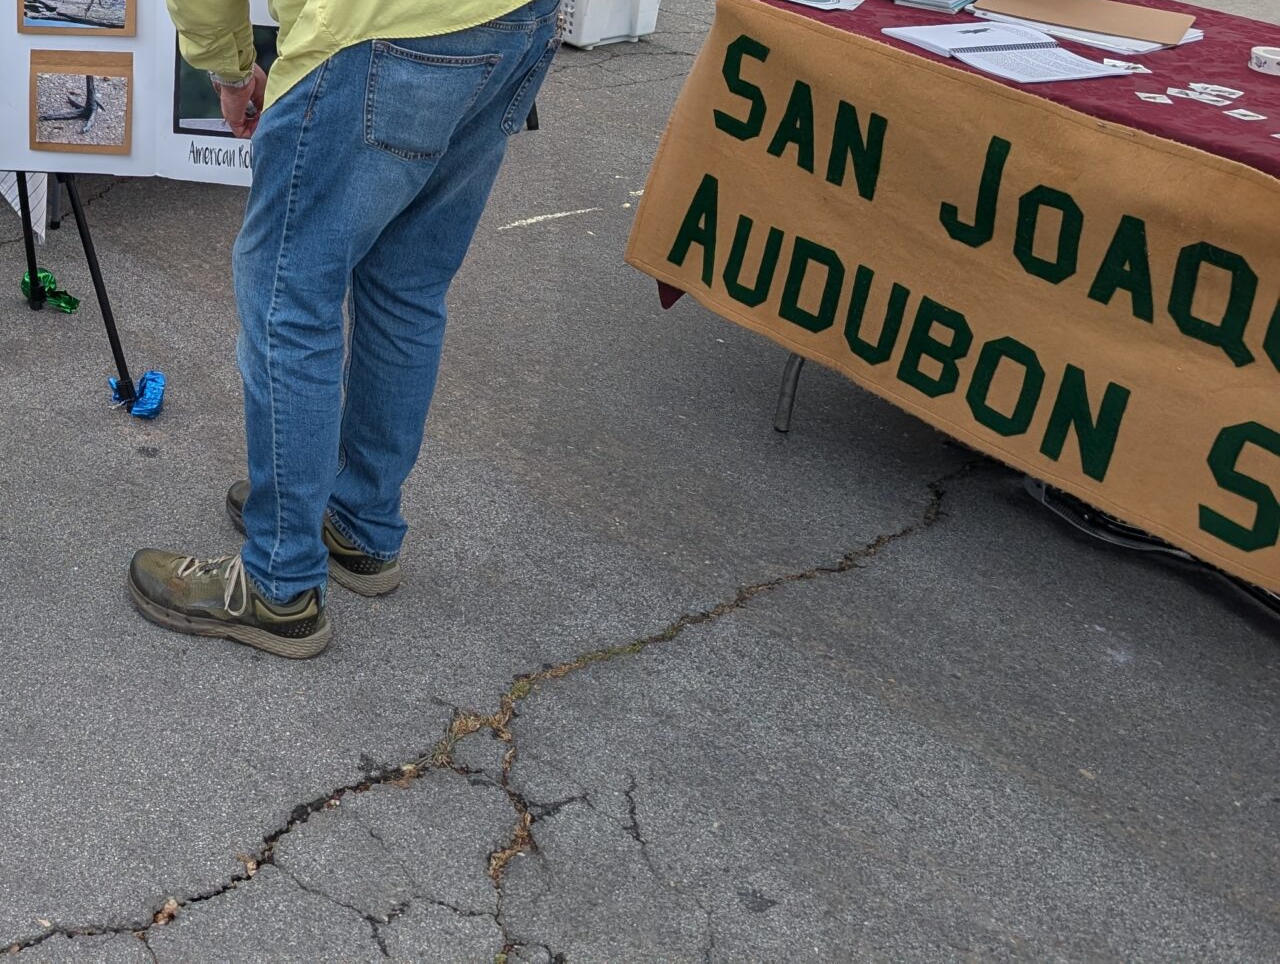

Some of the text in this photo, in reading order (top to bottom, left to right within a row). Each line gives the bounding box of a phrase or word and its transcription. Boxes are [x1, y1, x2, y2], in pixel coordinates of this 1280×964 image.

[189, 140, 236, 167] American
[713, 35, 888, 201] SAN
[667, 173, 1131, 482] AUDUBON
